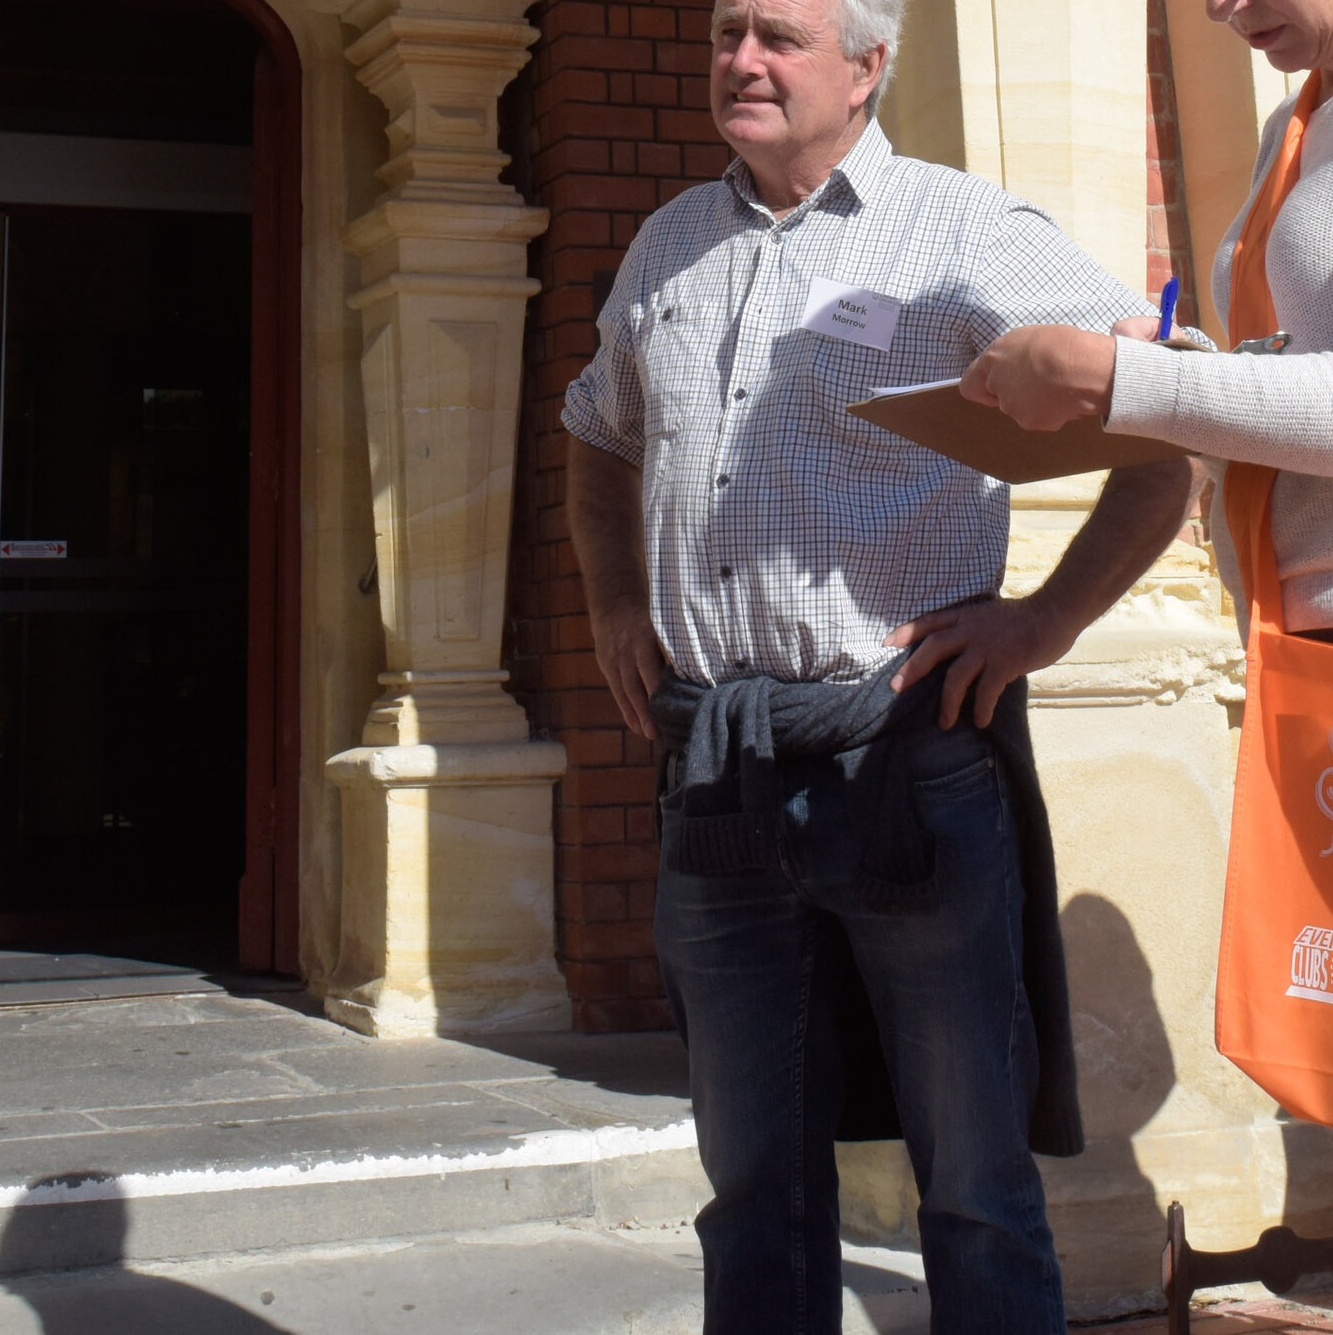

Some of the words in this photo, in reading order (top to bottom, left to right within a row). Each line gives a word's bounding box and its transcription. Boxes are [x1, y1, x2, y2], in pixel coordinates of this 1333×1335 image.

[837, 298, 868, 316] Mark
[831, 313, 866, 330] Morrow
[1291, 944, 1329, 991] CLUBS
